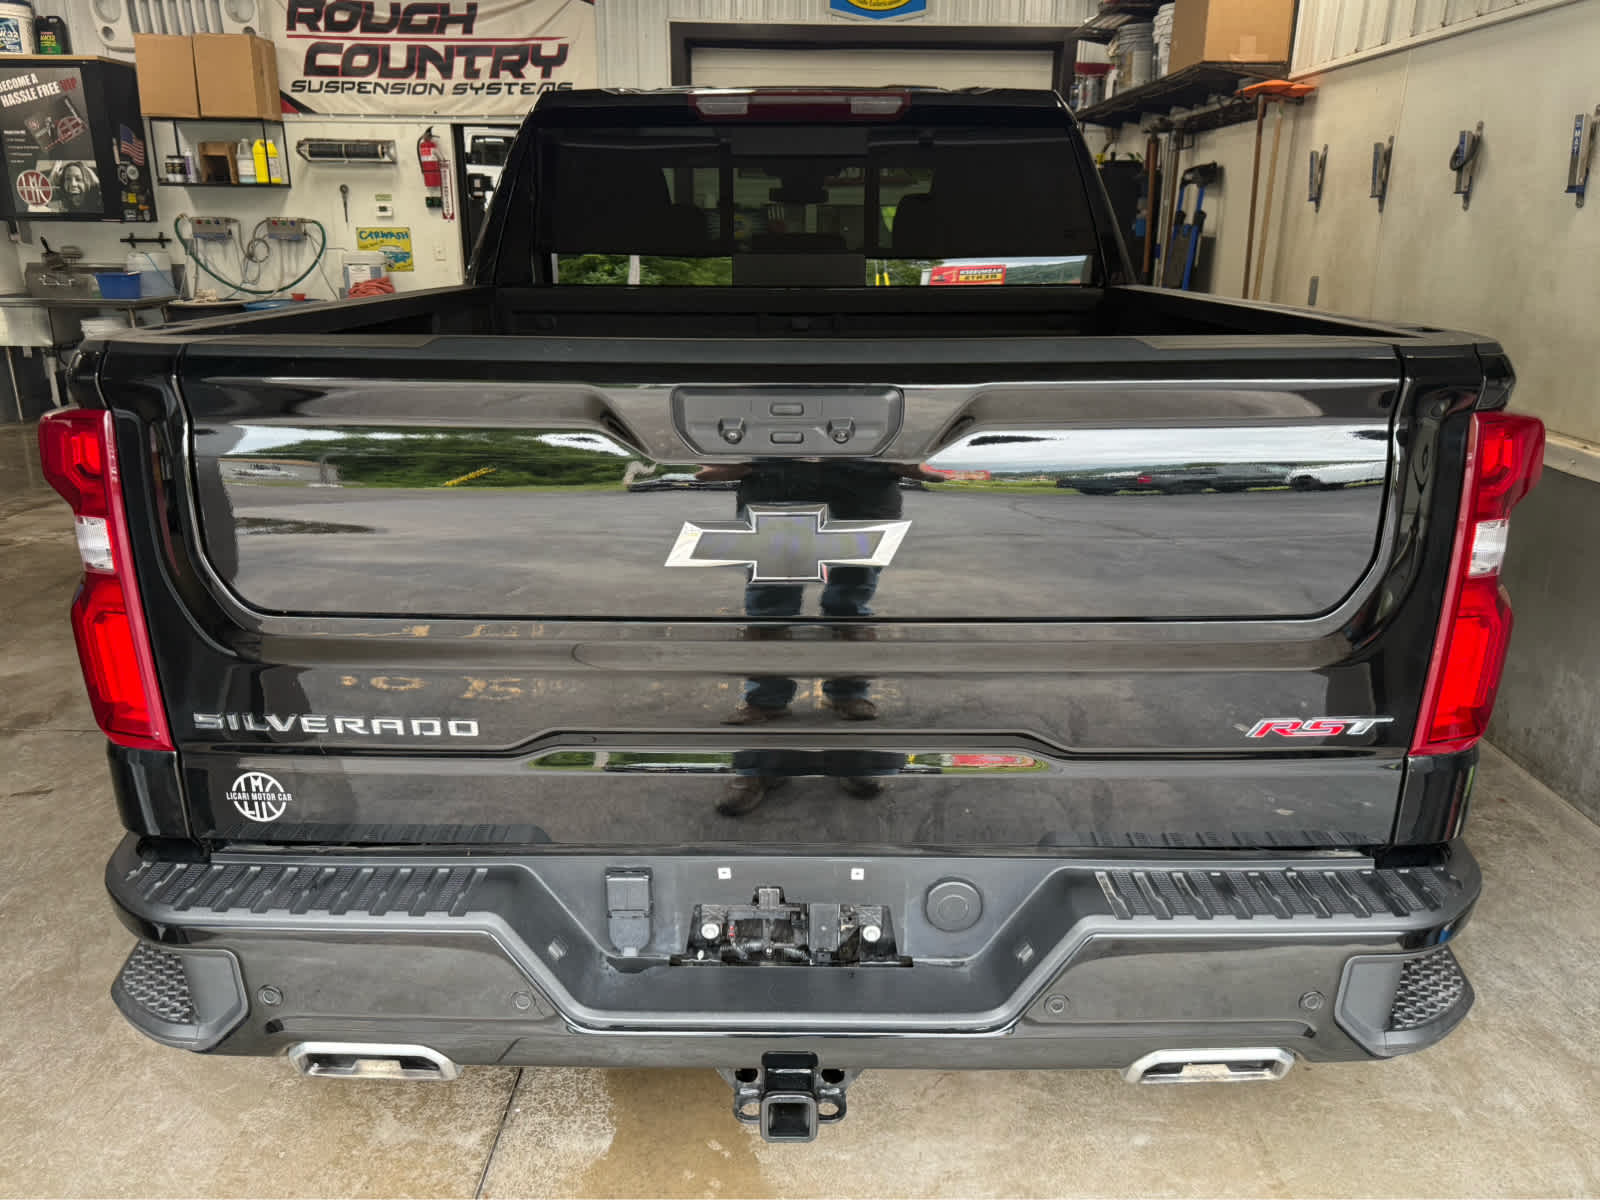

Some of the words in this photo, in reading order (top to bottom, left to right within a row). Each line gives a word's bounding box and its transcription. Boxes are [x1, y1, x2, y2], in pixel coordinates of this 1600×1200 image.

[286, 0, 478, 34] ROUGH
[303, 42, 569, 79] COUNTRY
[30, 73, 38, 84] A
[291, 80, 444, 96] SUSPENSION
[452, 82, 573, 96] SYSTEMS
[0, 87, 38, 108] HASSLE
[36, 81, 61, 98] FREE
[193, 712, 479, 737] SILVERADO
[1245, 716, 1394, 738] RST
[225, 791, 250, 801] LICARI
[251, 792, 276, 801] MOTOR
[277, 793, 293, 801] CAR
